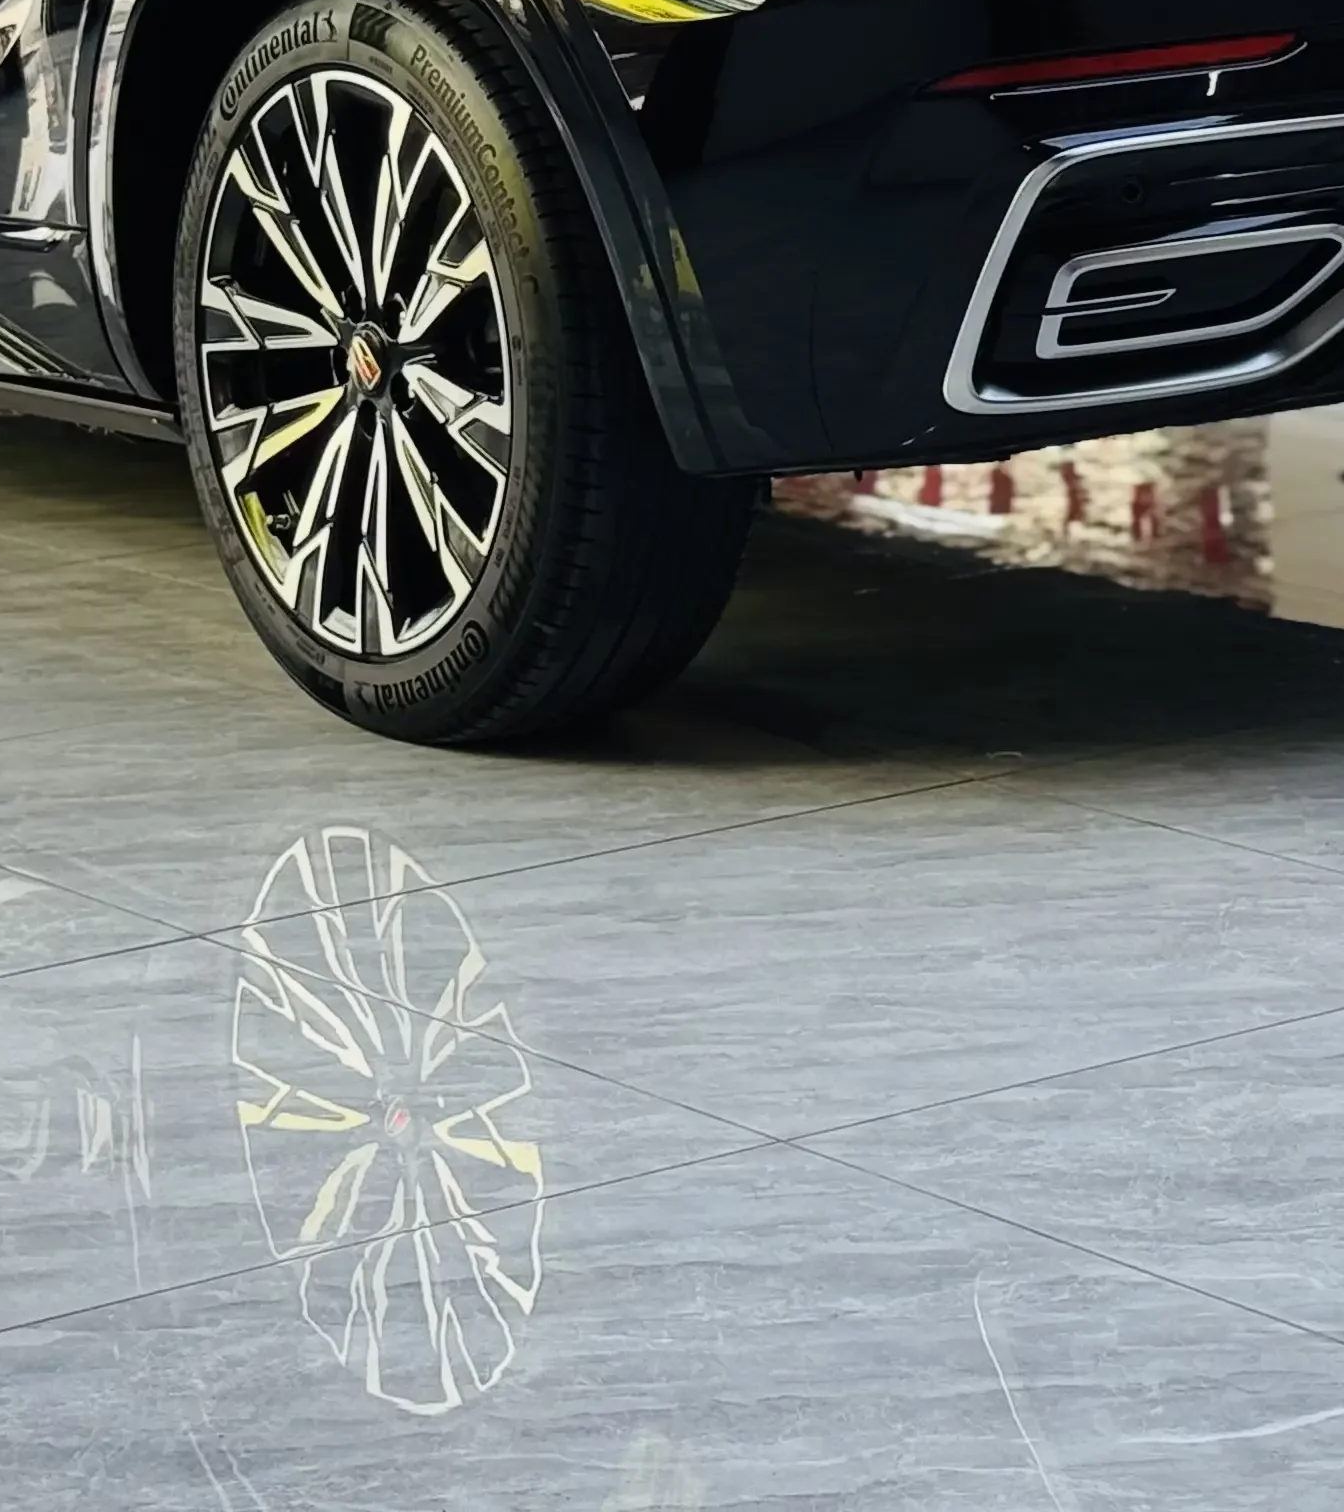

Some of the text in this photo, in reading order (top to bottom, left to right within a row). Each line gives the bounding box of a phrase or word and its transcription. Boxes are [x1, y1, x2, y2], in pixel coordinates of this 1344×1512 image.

[220, 11, 322, 121] Continental
[410, 43, 530, 264] PremiumContact
[373, 619, 490, 714] Continental
